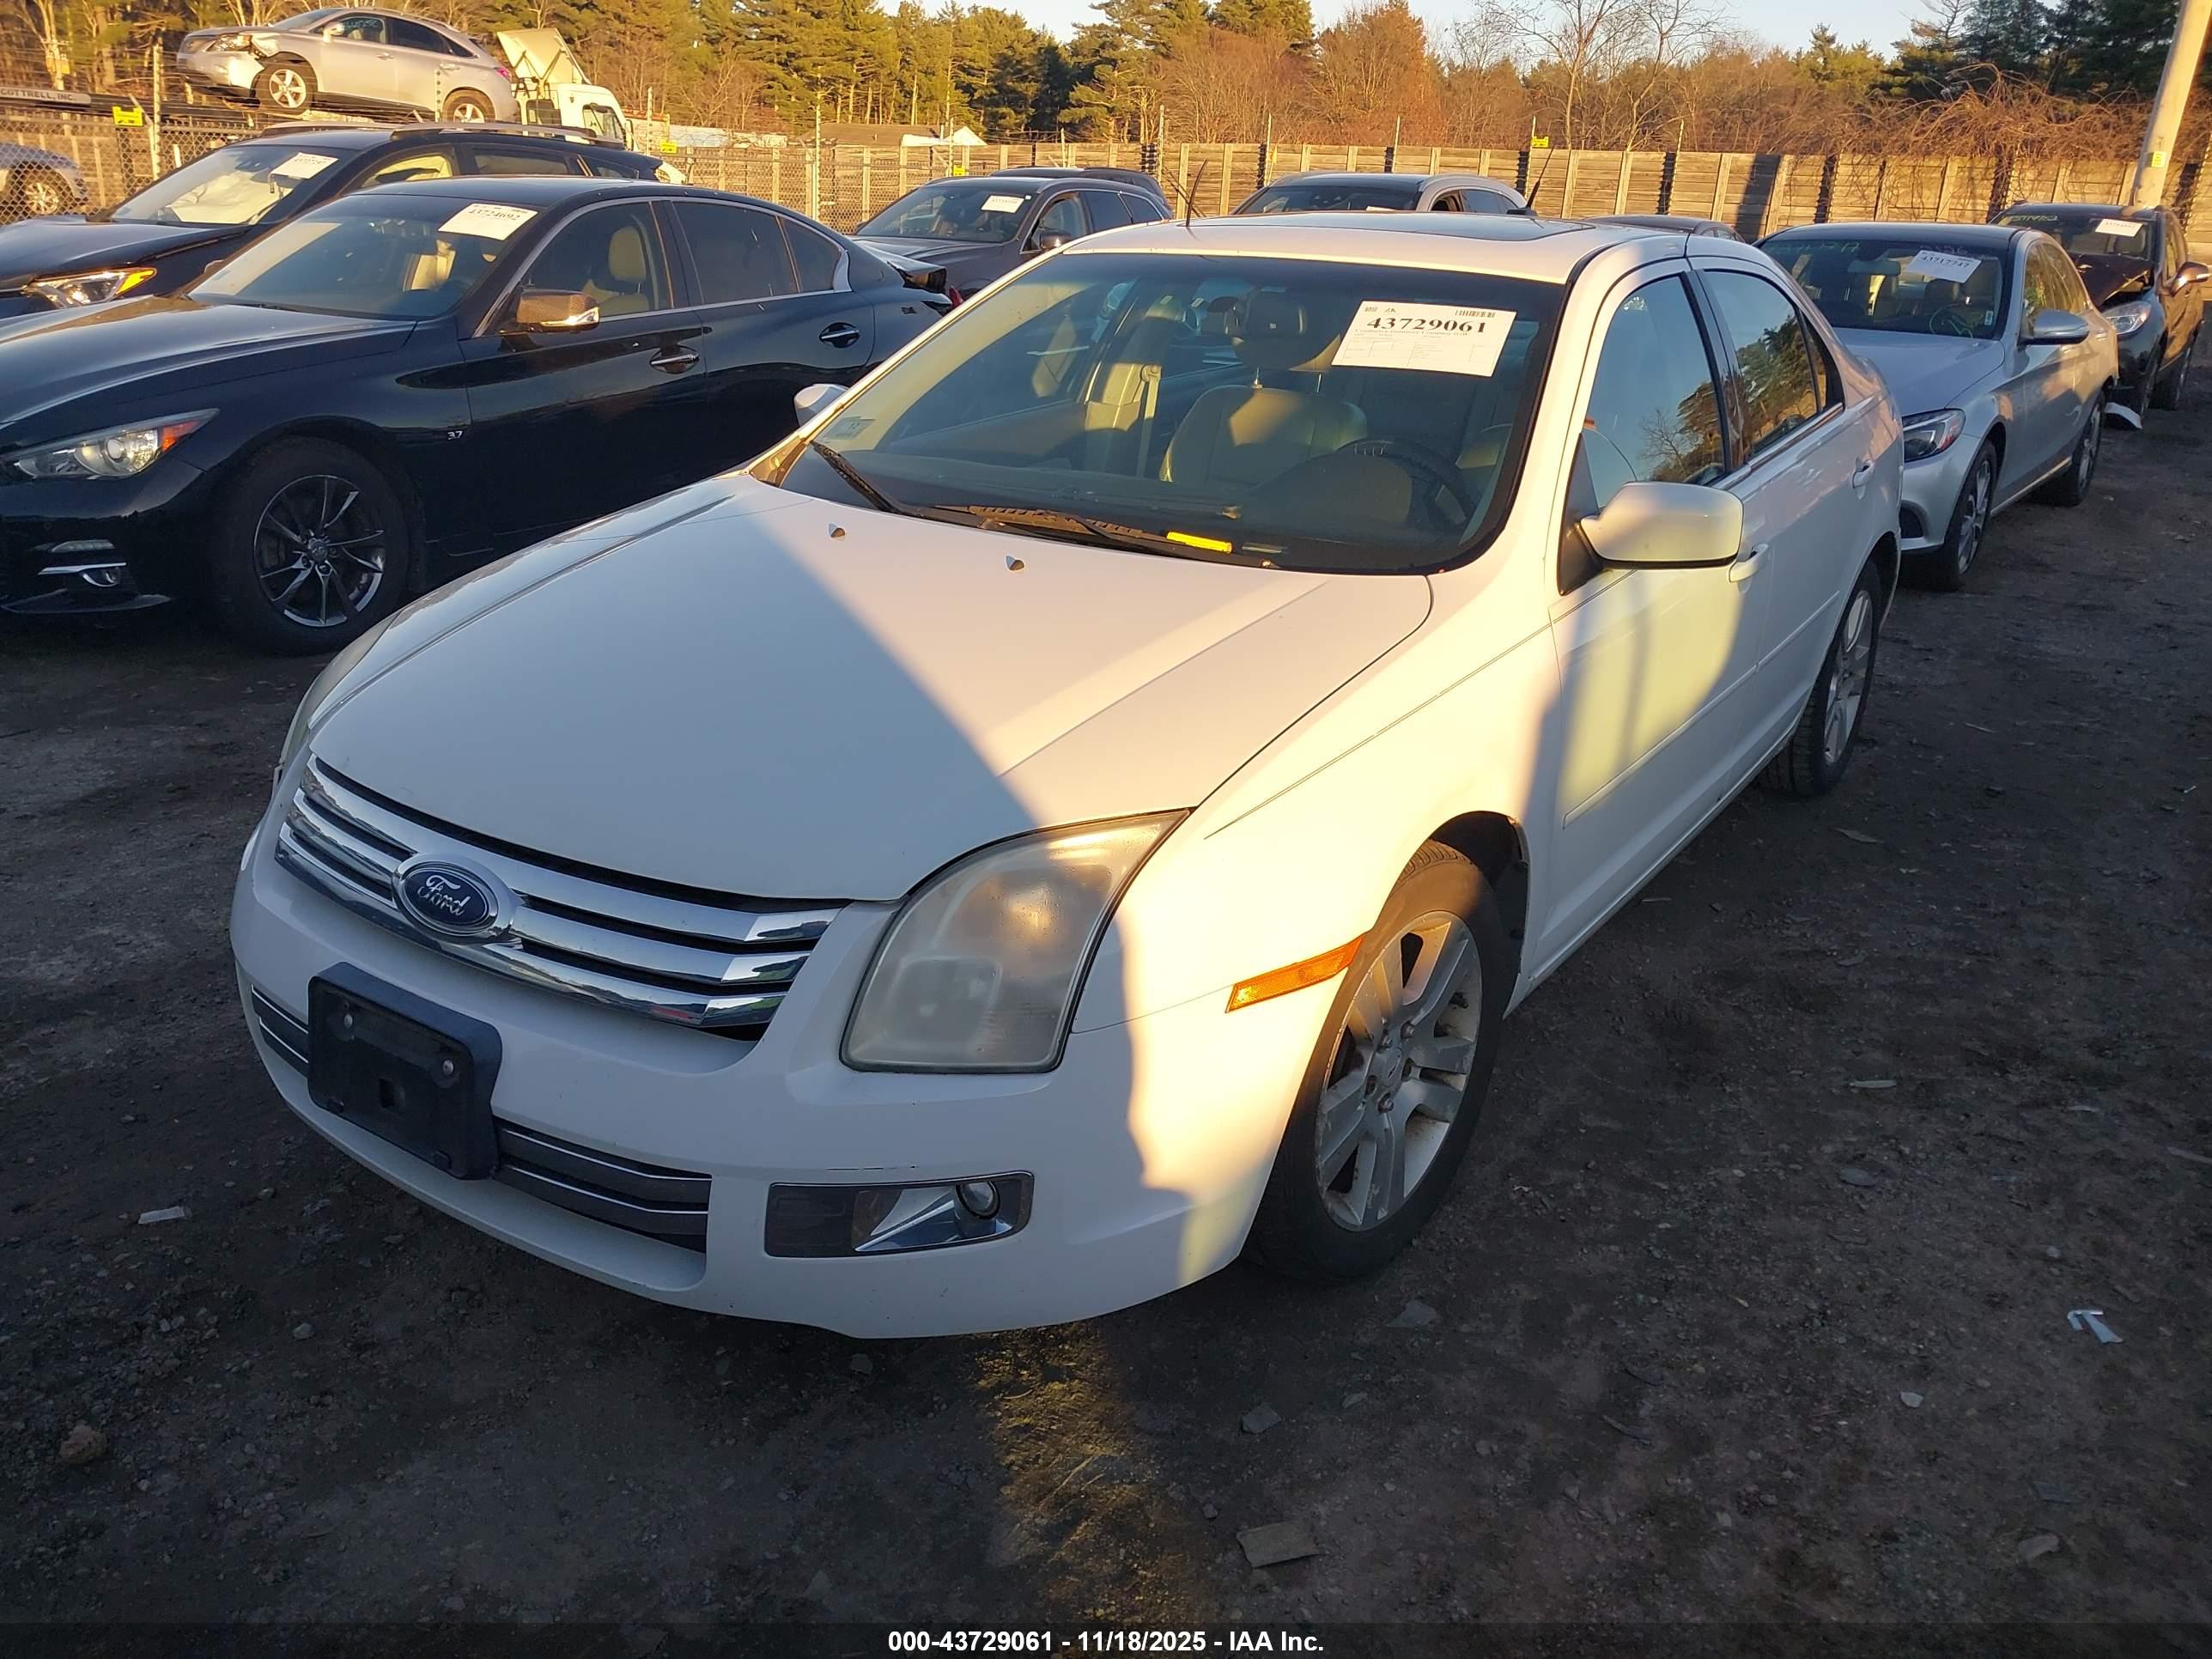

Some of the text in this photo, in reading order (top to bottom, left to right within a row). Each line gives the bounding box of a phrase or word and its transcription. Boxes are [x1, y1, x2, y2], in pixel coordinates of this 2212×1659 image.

[58, 93, 76, 101] INC.
[1366, 317, 1487, 333] 43729061
[417, 874, 471, 916] Ford
